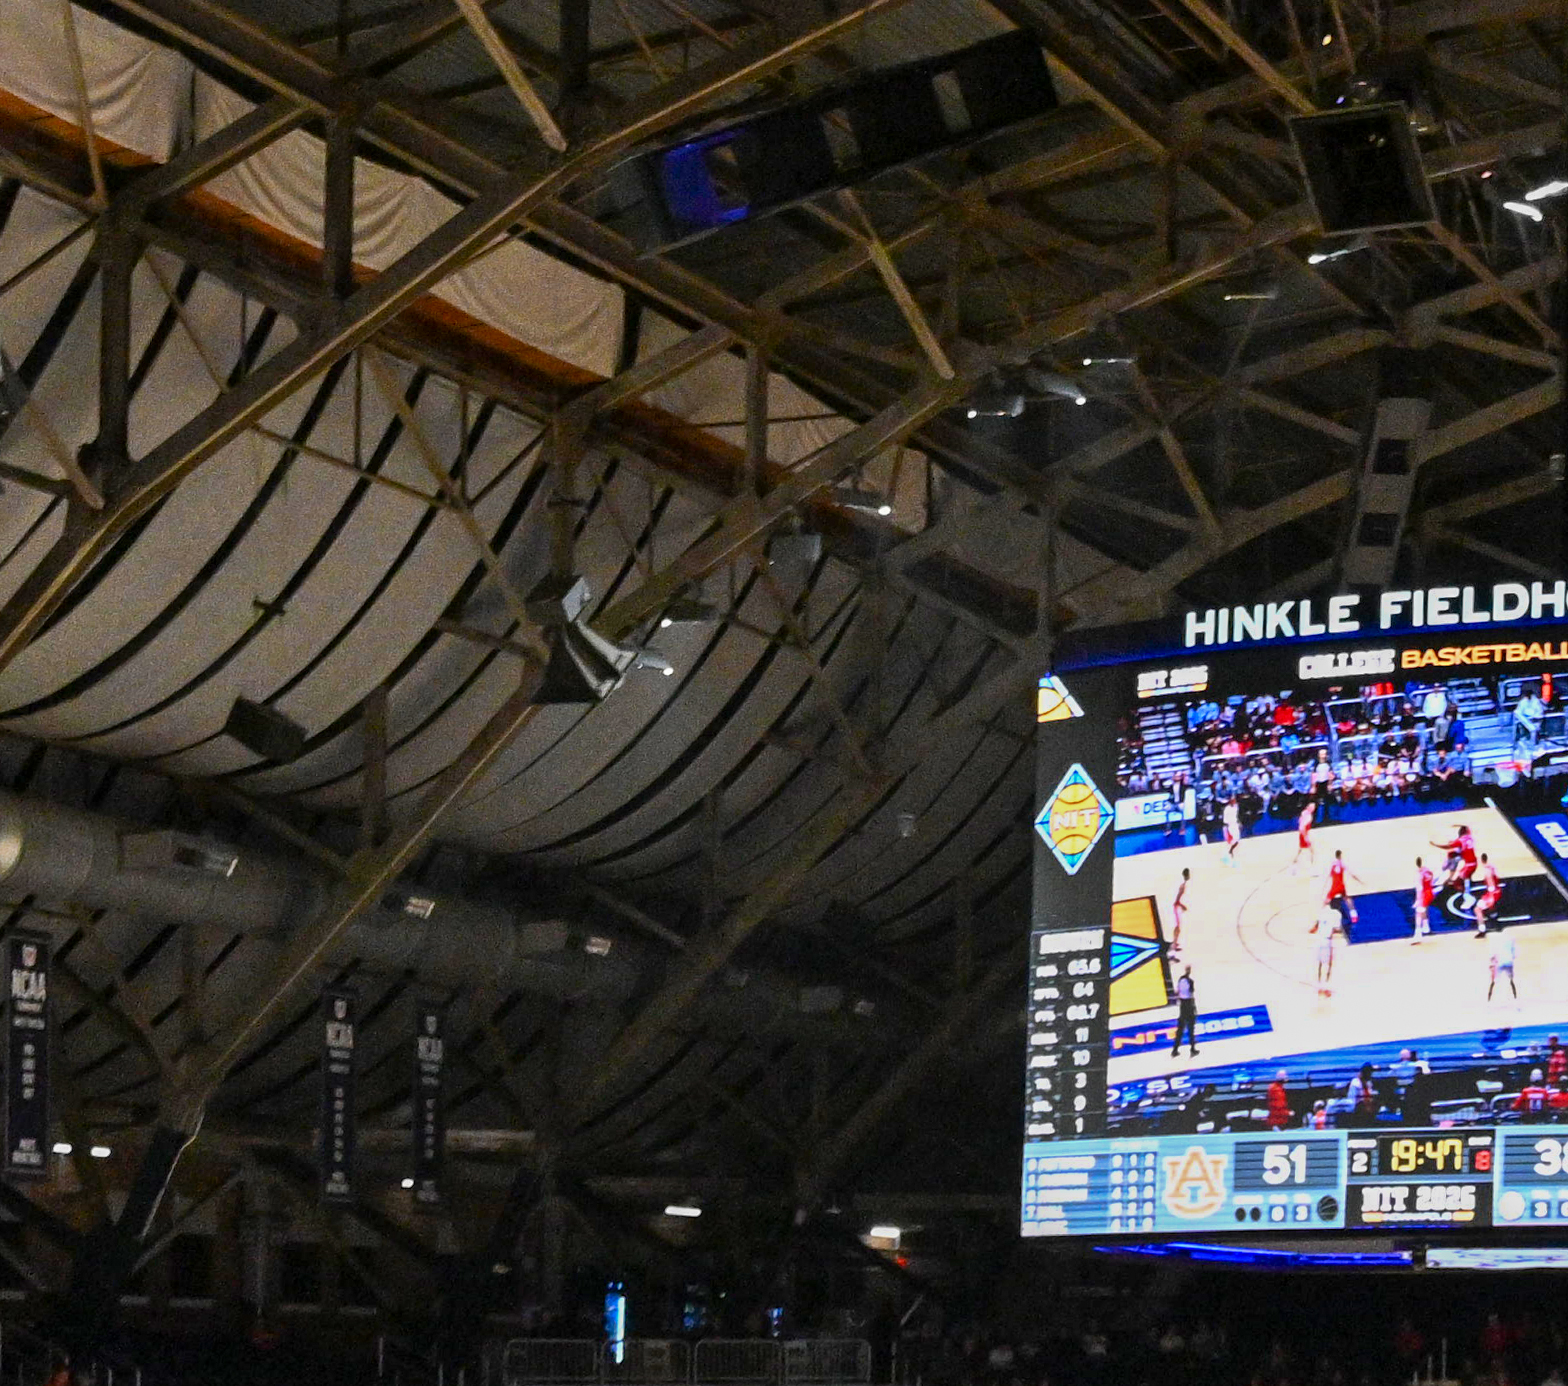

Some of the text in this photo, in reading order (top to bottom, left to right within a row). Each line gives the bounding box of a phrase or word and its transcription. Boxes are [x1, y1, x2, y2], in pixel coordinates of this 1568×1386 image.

[1184, 595, 1361, 648] HINKLE
[1053, 806, 1095, 831] NIT
[1073, 982, 1094, 997] 64
[1112, 1027, 1179, 1050] NIT
[1262, 1144, 1307, 1184] 51
[1352, 1151, 1369, 1174] 2
[1390, 1138, 1463, 1172] 19:47
[1361, 1186, 1408, 1212] NIT
